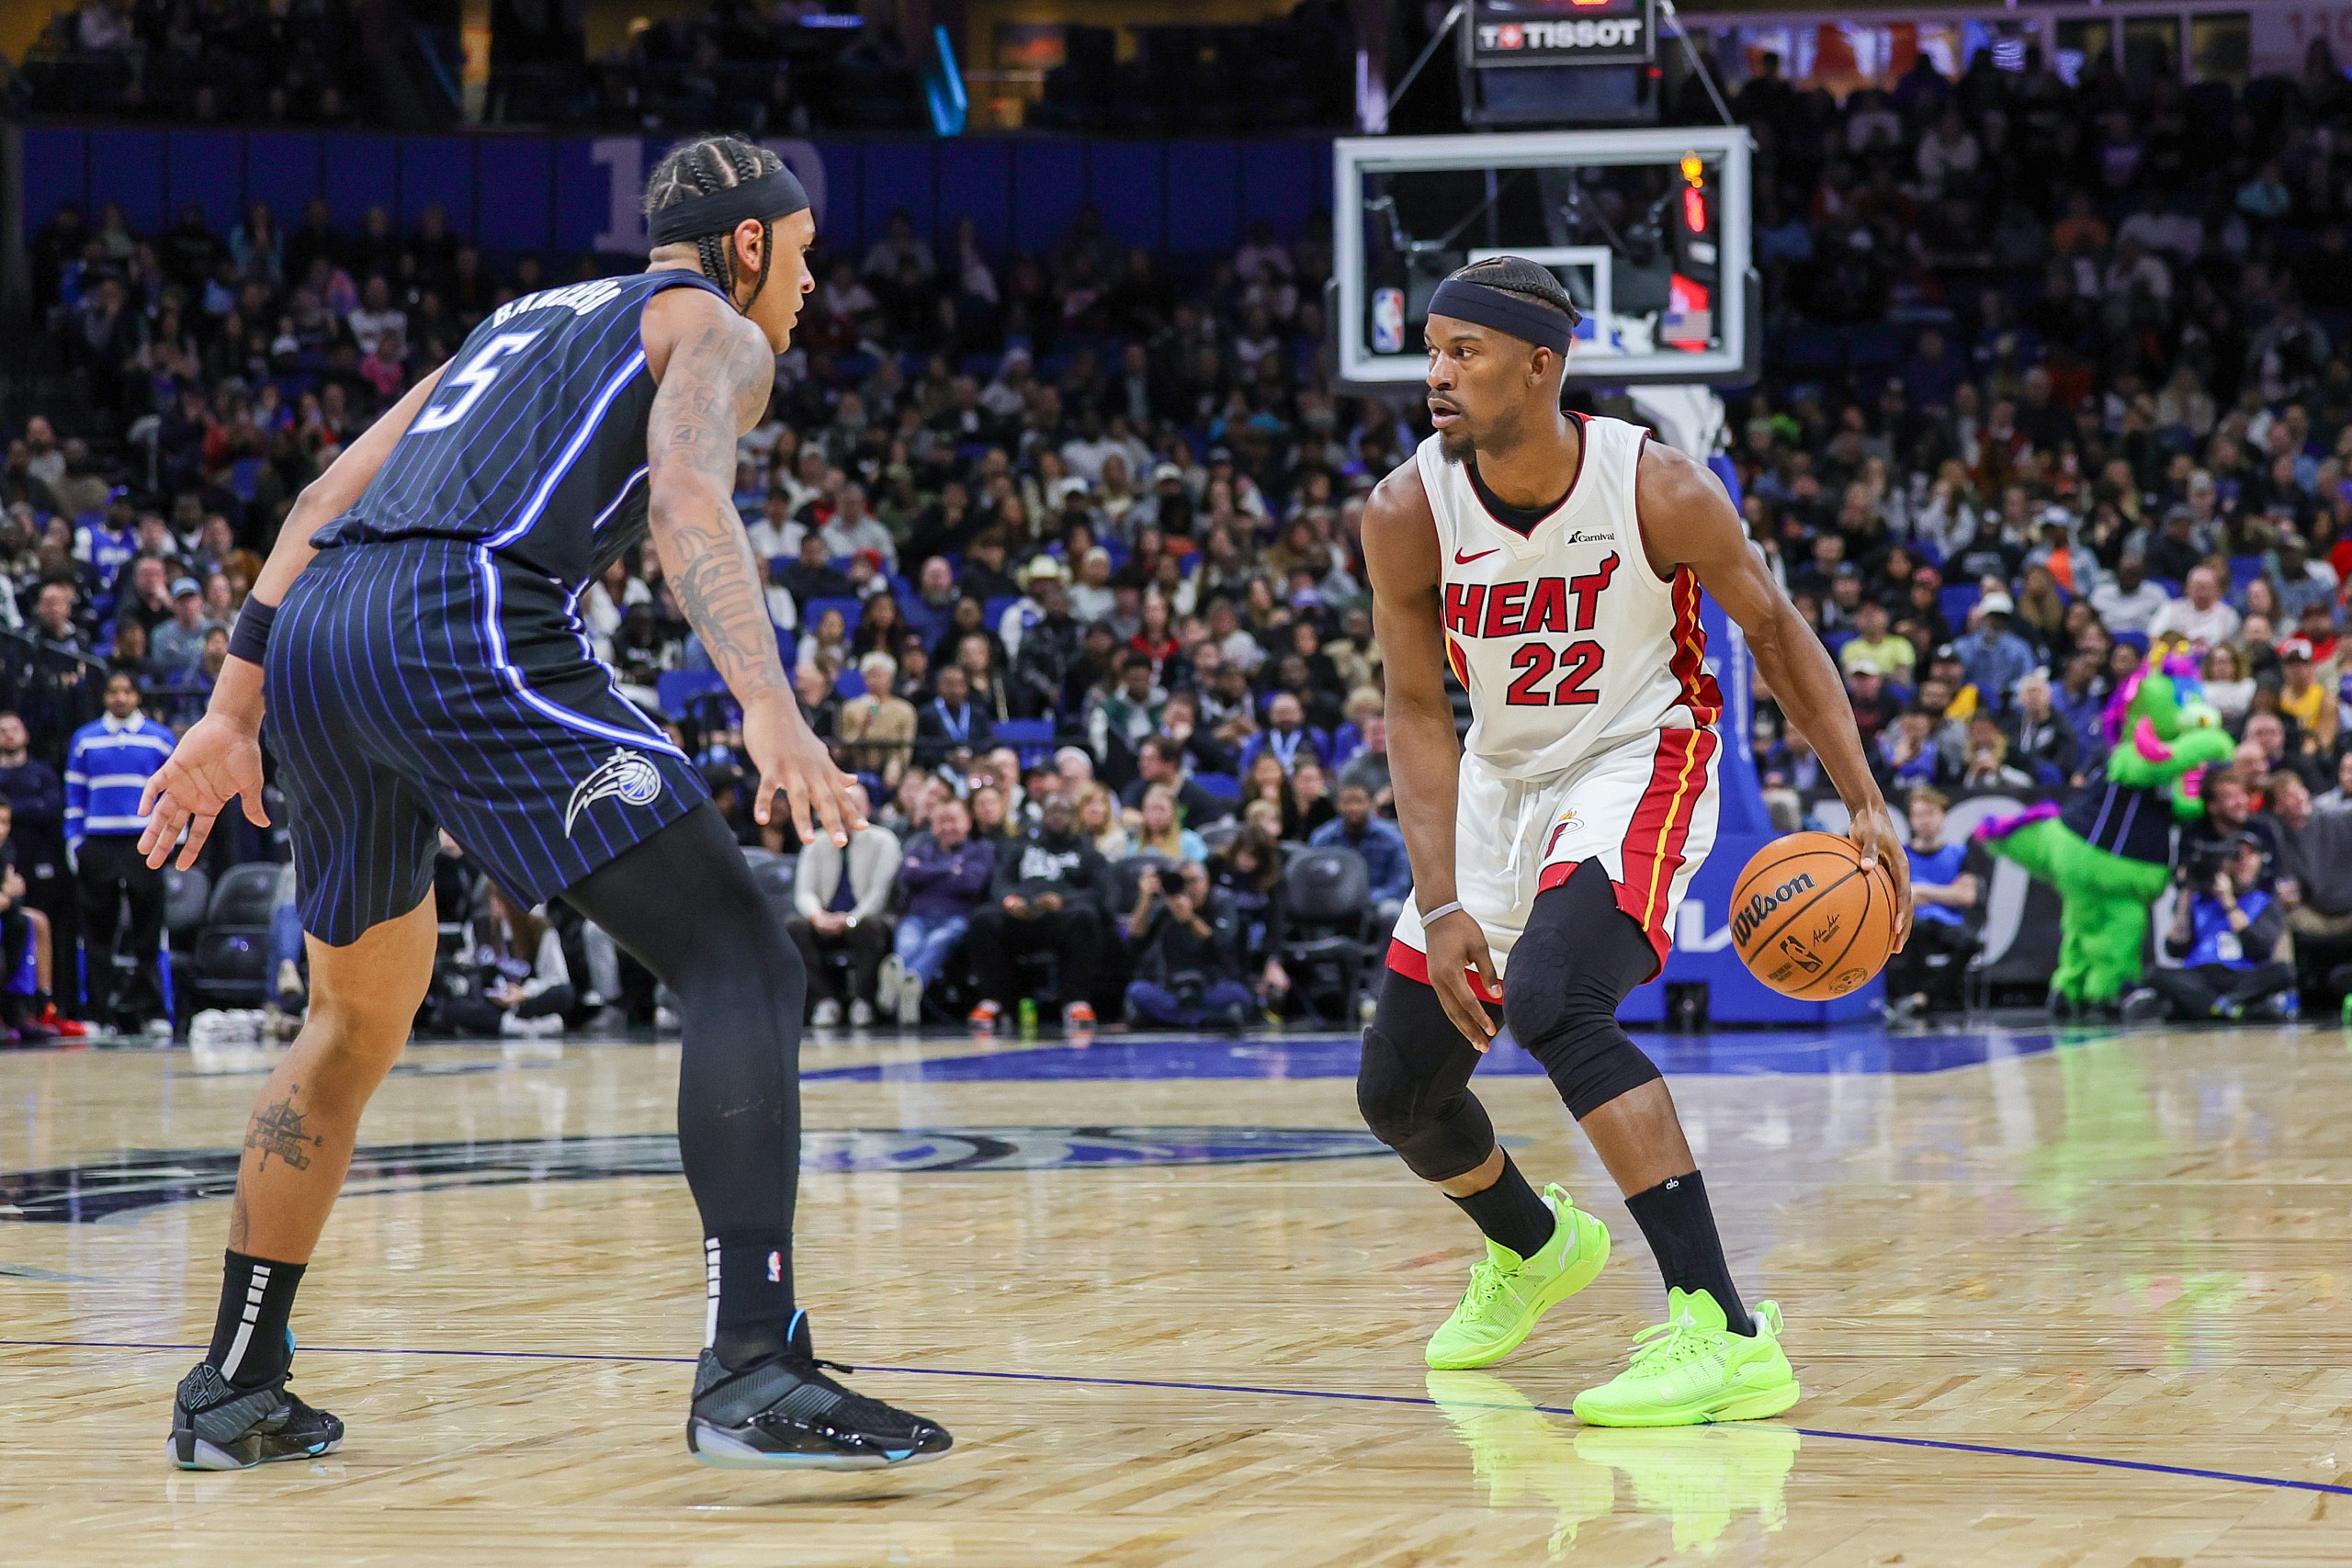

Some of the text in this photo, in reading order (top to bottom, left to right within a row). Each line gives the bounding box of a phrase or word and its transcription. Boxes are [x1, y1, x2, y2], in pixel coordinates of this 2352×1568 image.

[1522, 18, 1643, 49] TISSOT
[407, 327, 545, 435] 5
[1577, 532, 1615, 543] Carnival
[1445, 550, 1620, 638] HEAT
[1506, 640, 1605, 705] 22
[1731, 874, 1817, 948] Wilson
[1666, 1178, 1679, 1190] alo
